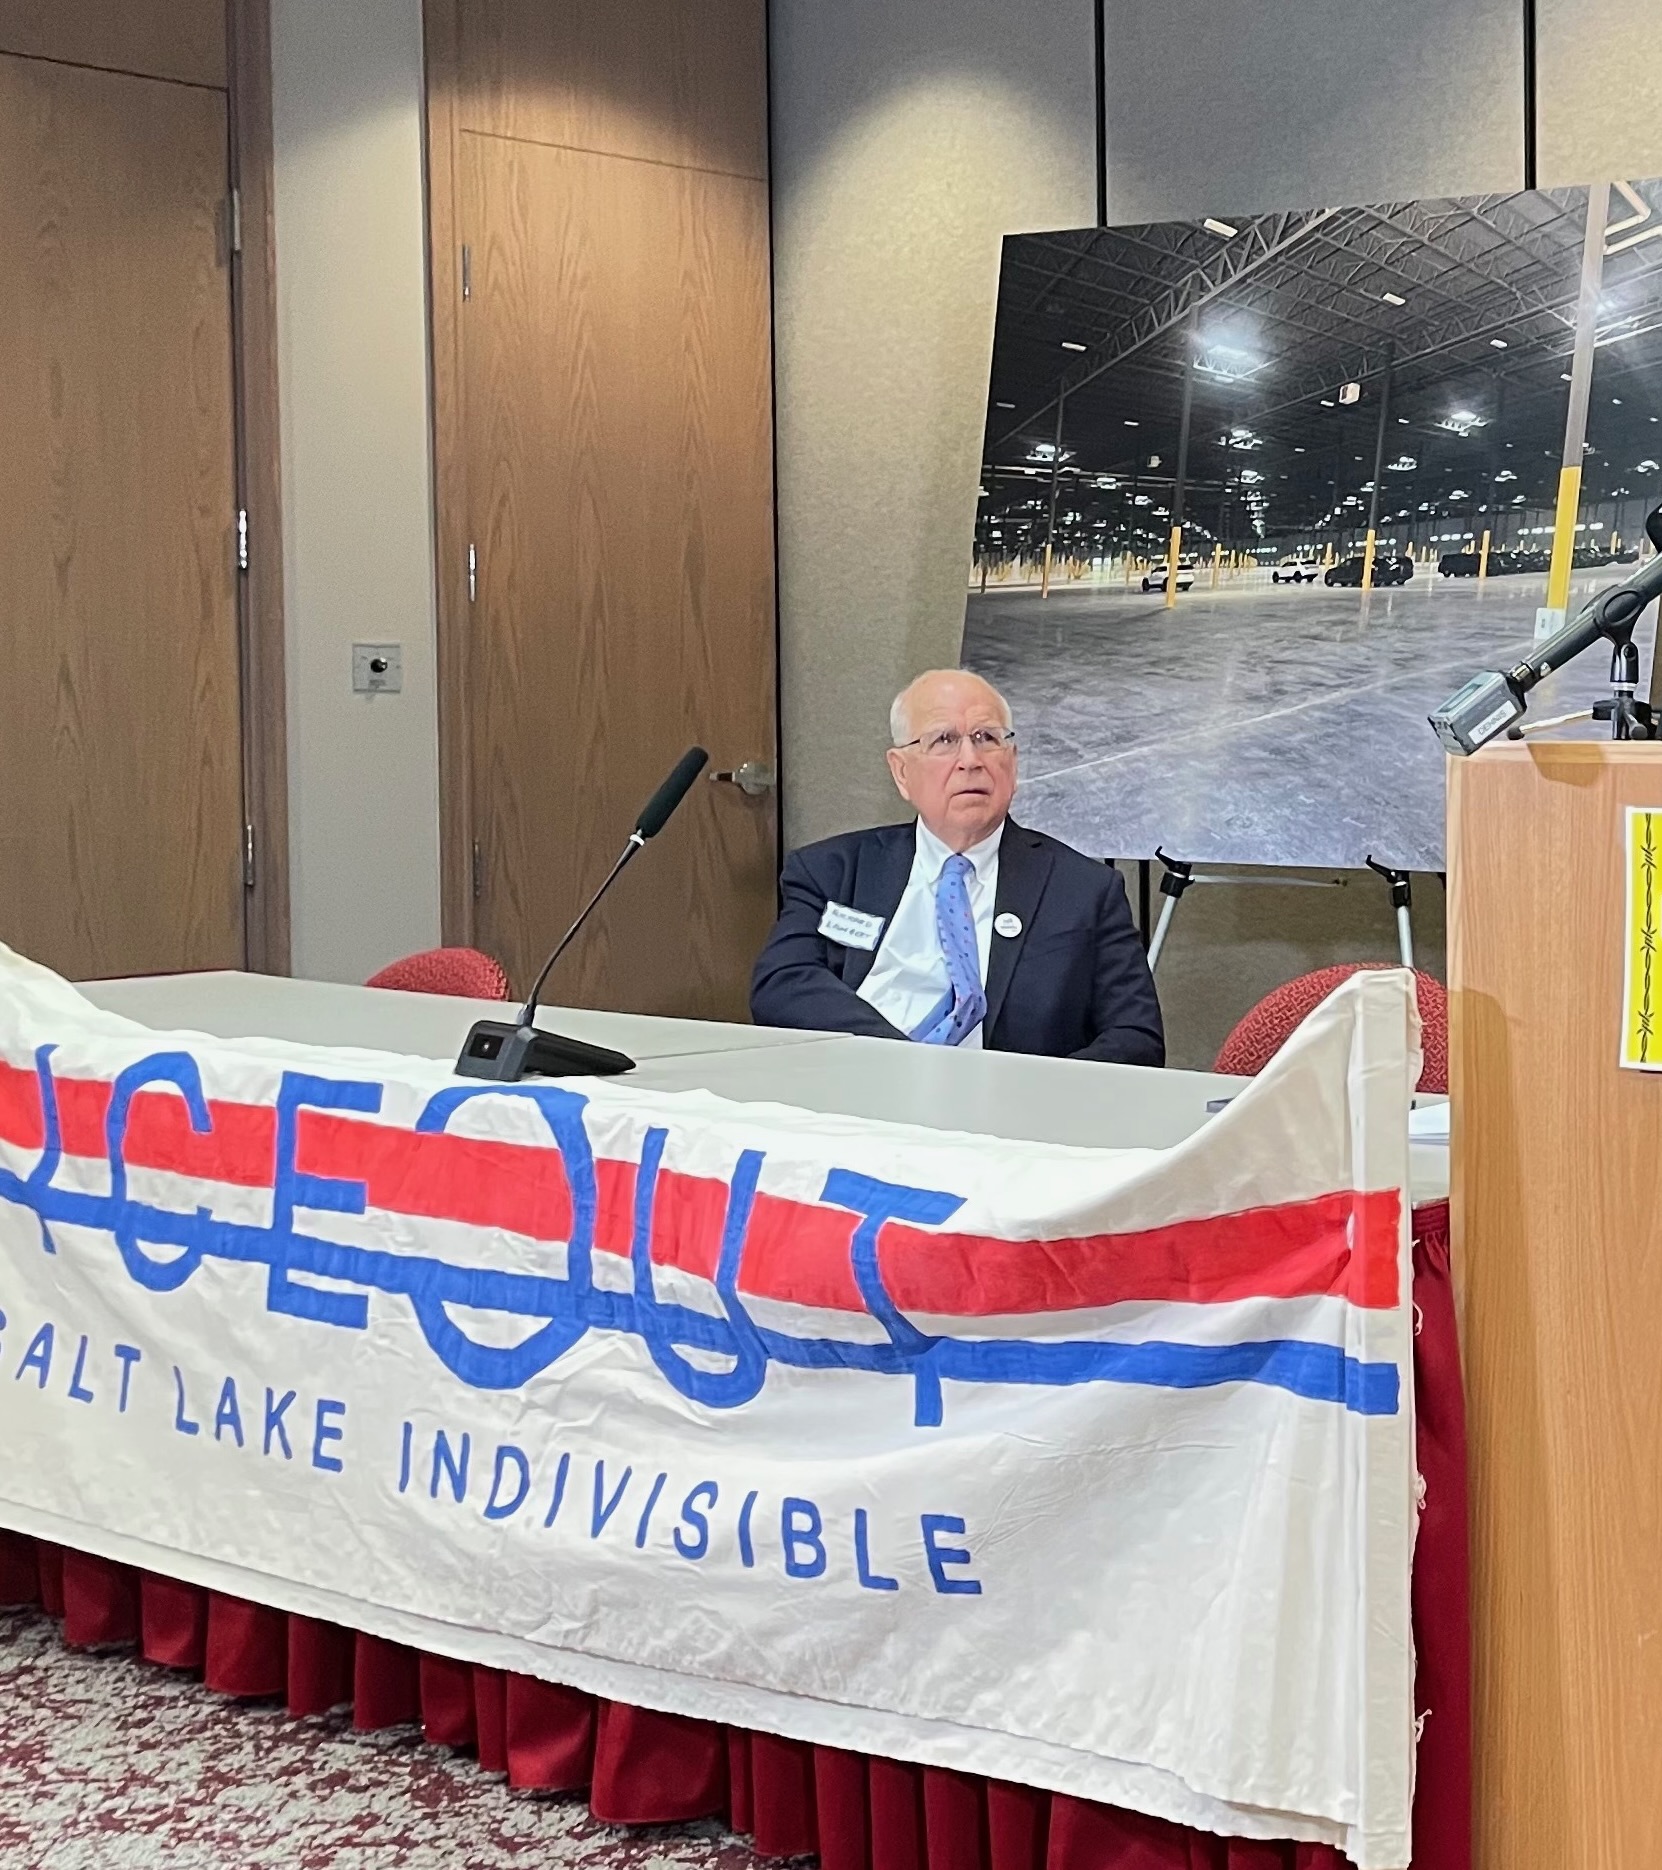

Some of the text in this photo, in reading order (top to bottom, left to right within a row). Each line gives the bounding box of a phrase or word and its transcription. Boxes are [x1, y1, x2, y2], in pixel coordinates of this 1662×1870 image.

[1477, 709, 1508, 736] DENNIS
[0, 1309, 984, 1597] ALT LAKE INDIVISIBLE
